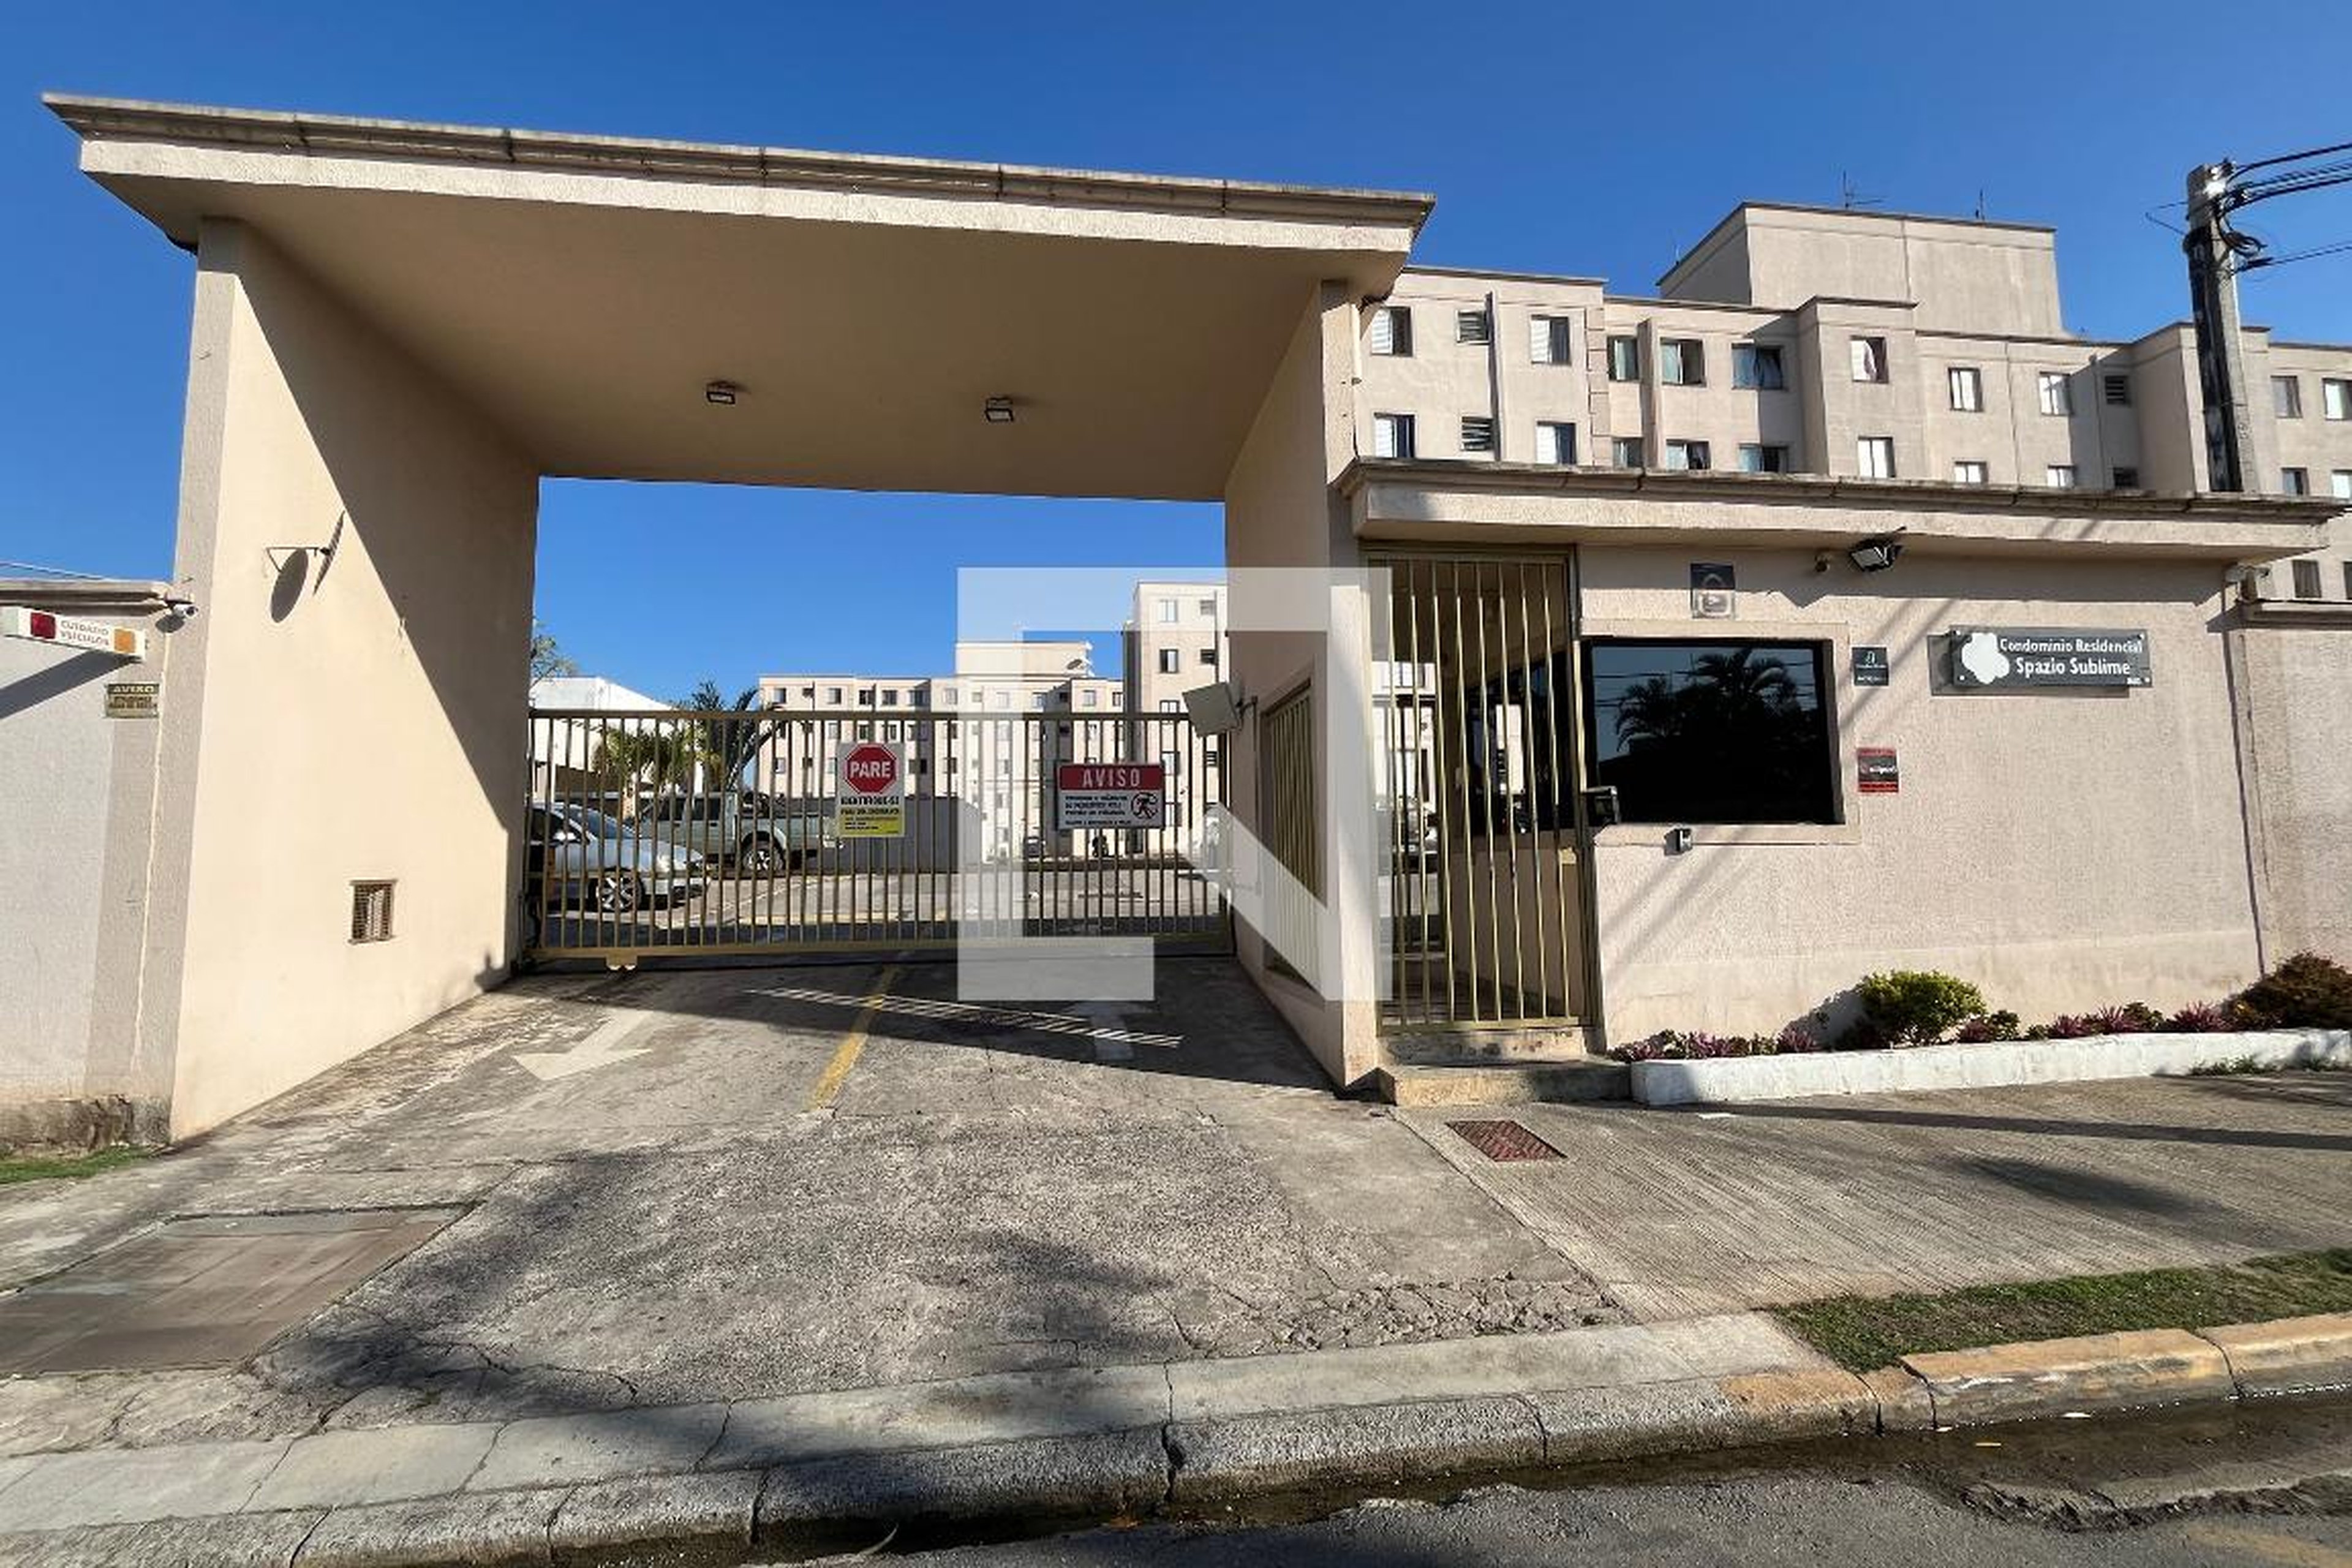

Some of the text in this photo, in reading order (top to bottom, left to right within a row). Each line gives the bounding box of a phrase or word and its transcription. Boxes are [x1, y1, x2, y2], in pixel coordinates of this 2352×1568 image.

[2076, 638, 2143, 653] Residencial
[2016, 657, 2130, 678] Spazio Sublime
[849, 761, 892, 778] PARE
[1082, 768, 1140, 788] AVISO
